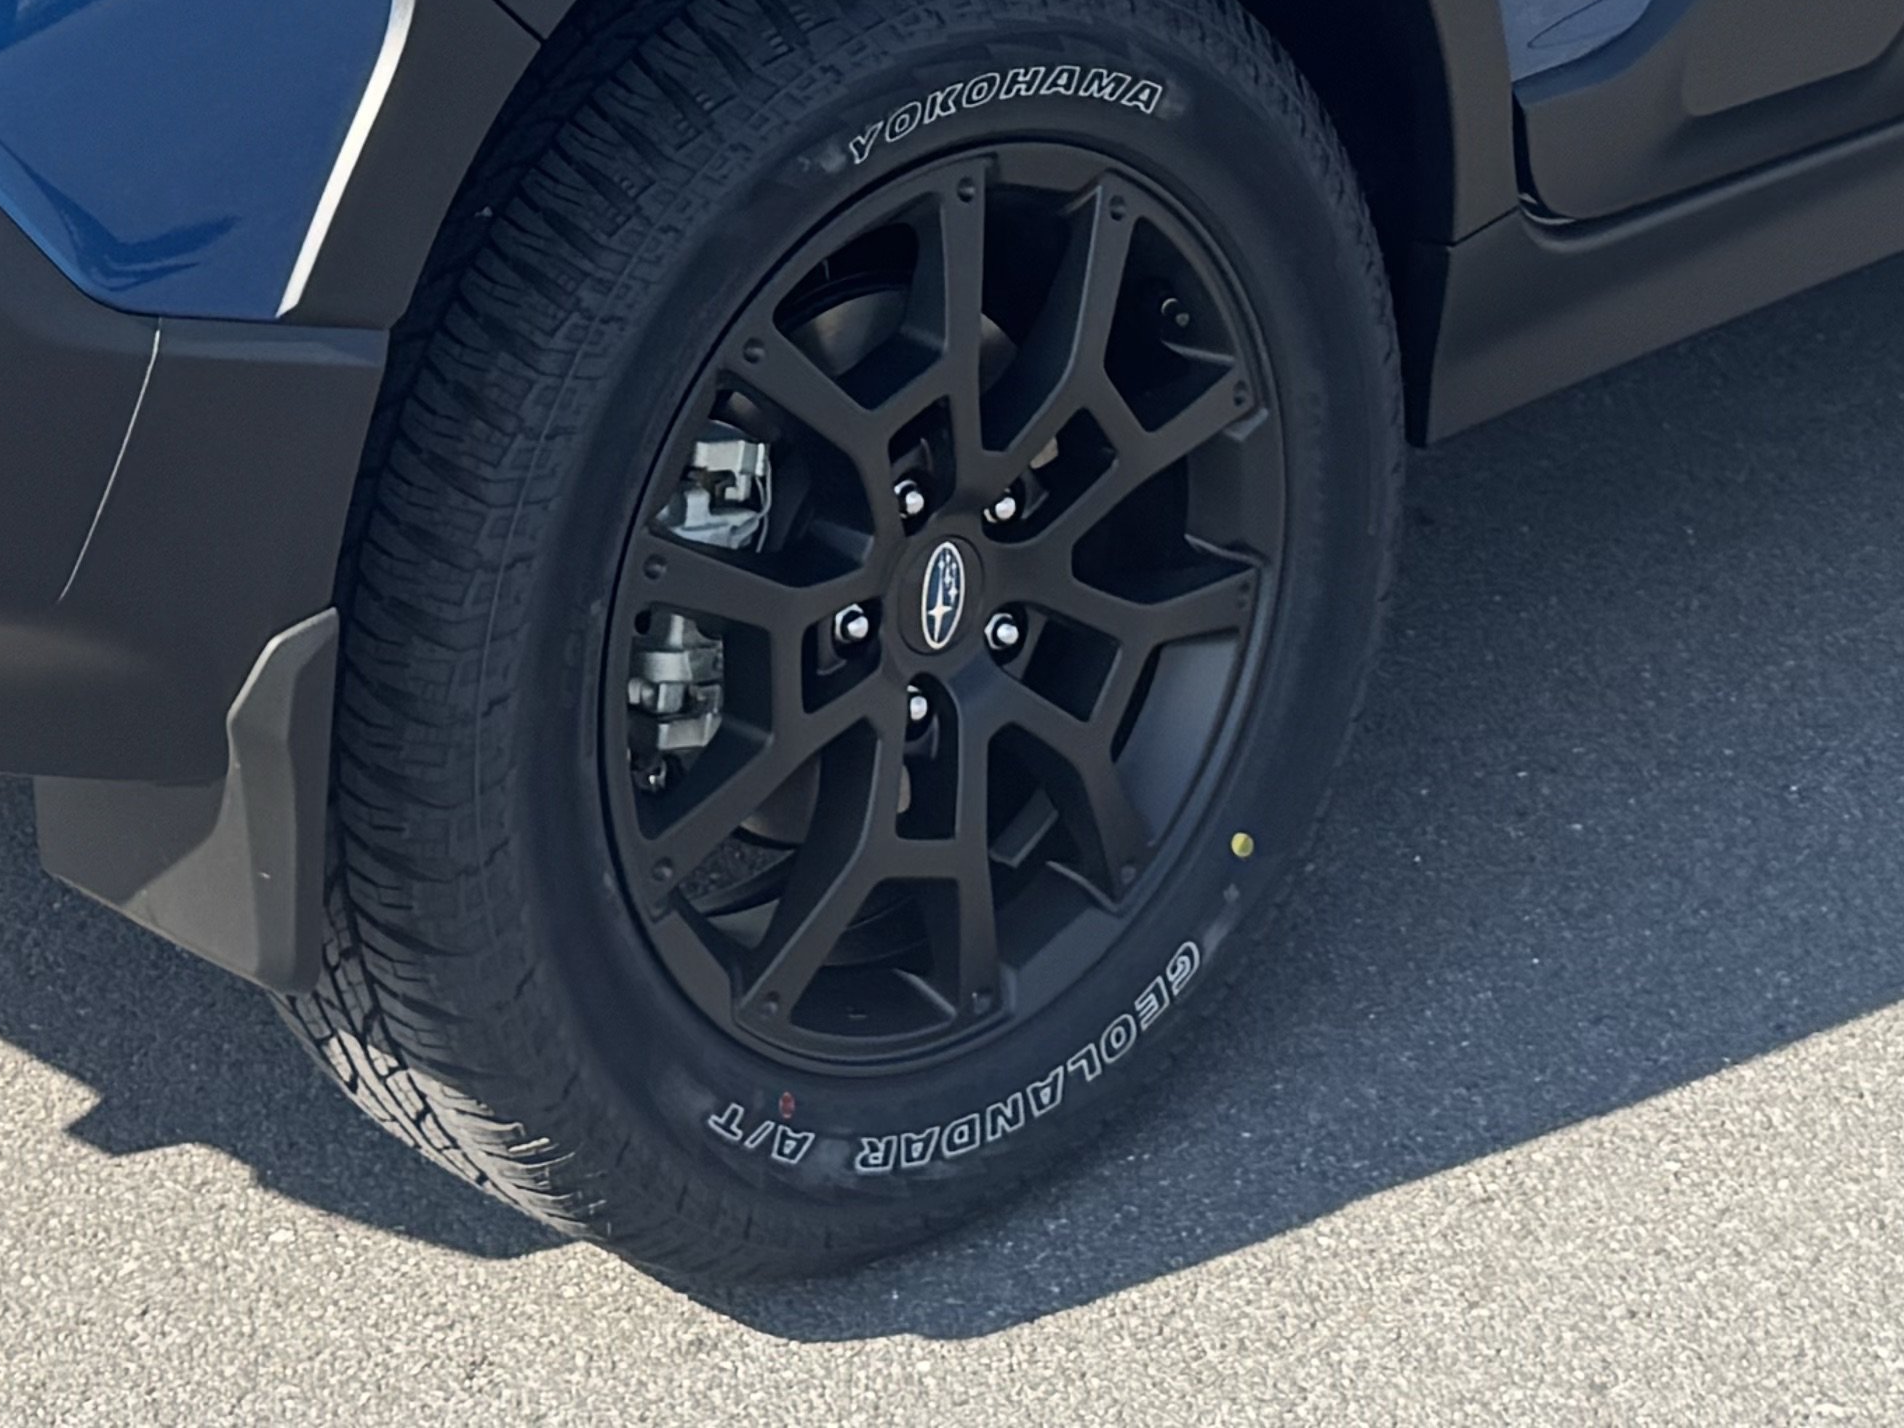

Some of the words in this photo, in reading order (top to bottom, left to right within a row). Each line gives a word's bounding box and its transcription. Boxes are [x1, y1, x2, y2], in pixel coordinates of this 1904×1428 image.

[848, 65, 1163, 164] YOKOHAMA
[854, 940, 1201, 1174] GEOLANDAR
[707, 1102, 815, 1164] A/T
